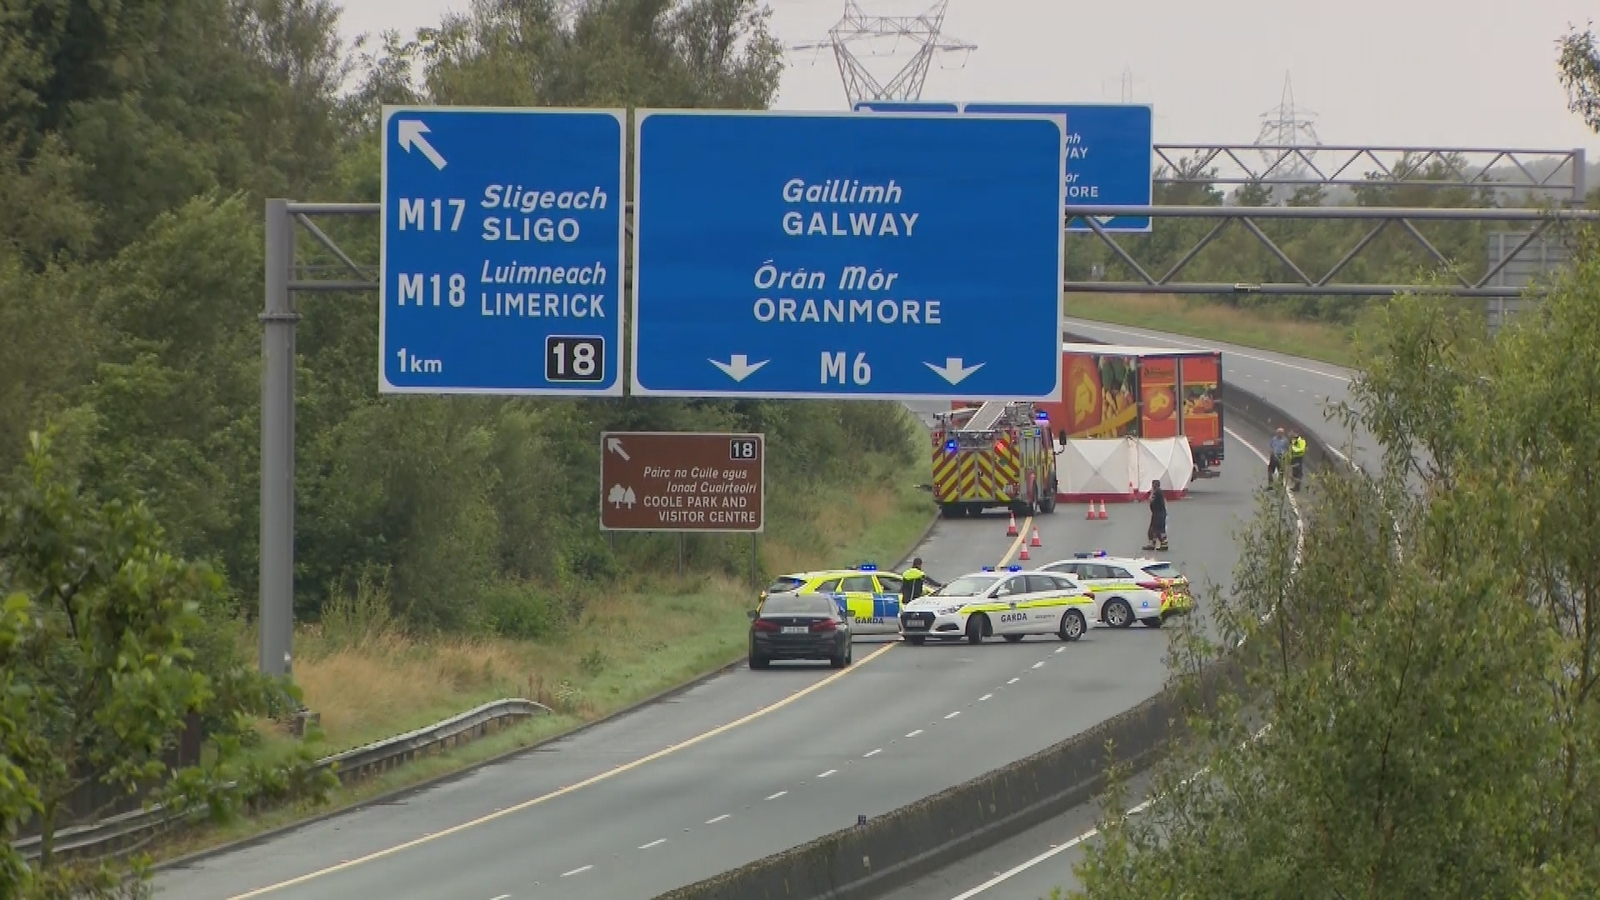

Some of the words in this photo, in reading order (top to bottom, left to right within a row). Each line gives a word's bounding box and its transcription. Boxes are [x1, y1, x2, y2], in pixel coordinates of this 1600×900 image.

[481, 184, 607, 213] Sligeach
[783, 179, 902, 203] Gaillimh
[399, 197, 466, 231] M17
[783, 212, 919, 236] GALWAY
[481, 217, 580, 242] SLIGO
[480, 259, 607, 285] Luimneach
[754, 260, 826, 290] Órán
[839, 266, 899, 291] Mór
[398, 273, 466, 307] M18
[481, 292, 605, 317] LIMERICK
[753, 297, 942, 325] ORANMORE
[553, 342, 596, 376] 18
[820, 352, 871, 386] M6
[732, 441, 753, 458] 18
[674, 468, 687, 478] na
[722, 469, 747, 481] agus
[643, 496, 683, 508] COOLE
[687, 496, 718, 508] PARK
[721, 496, 747, 508] AND
[658, 510, 705, 523] VISITOR
[709, 511, 756, 523] CENTRE
[855, 616, 884, 625] GARDA
[1001, 612, 1028, 623] GARDA
